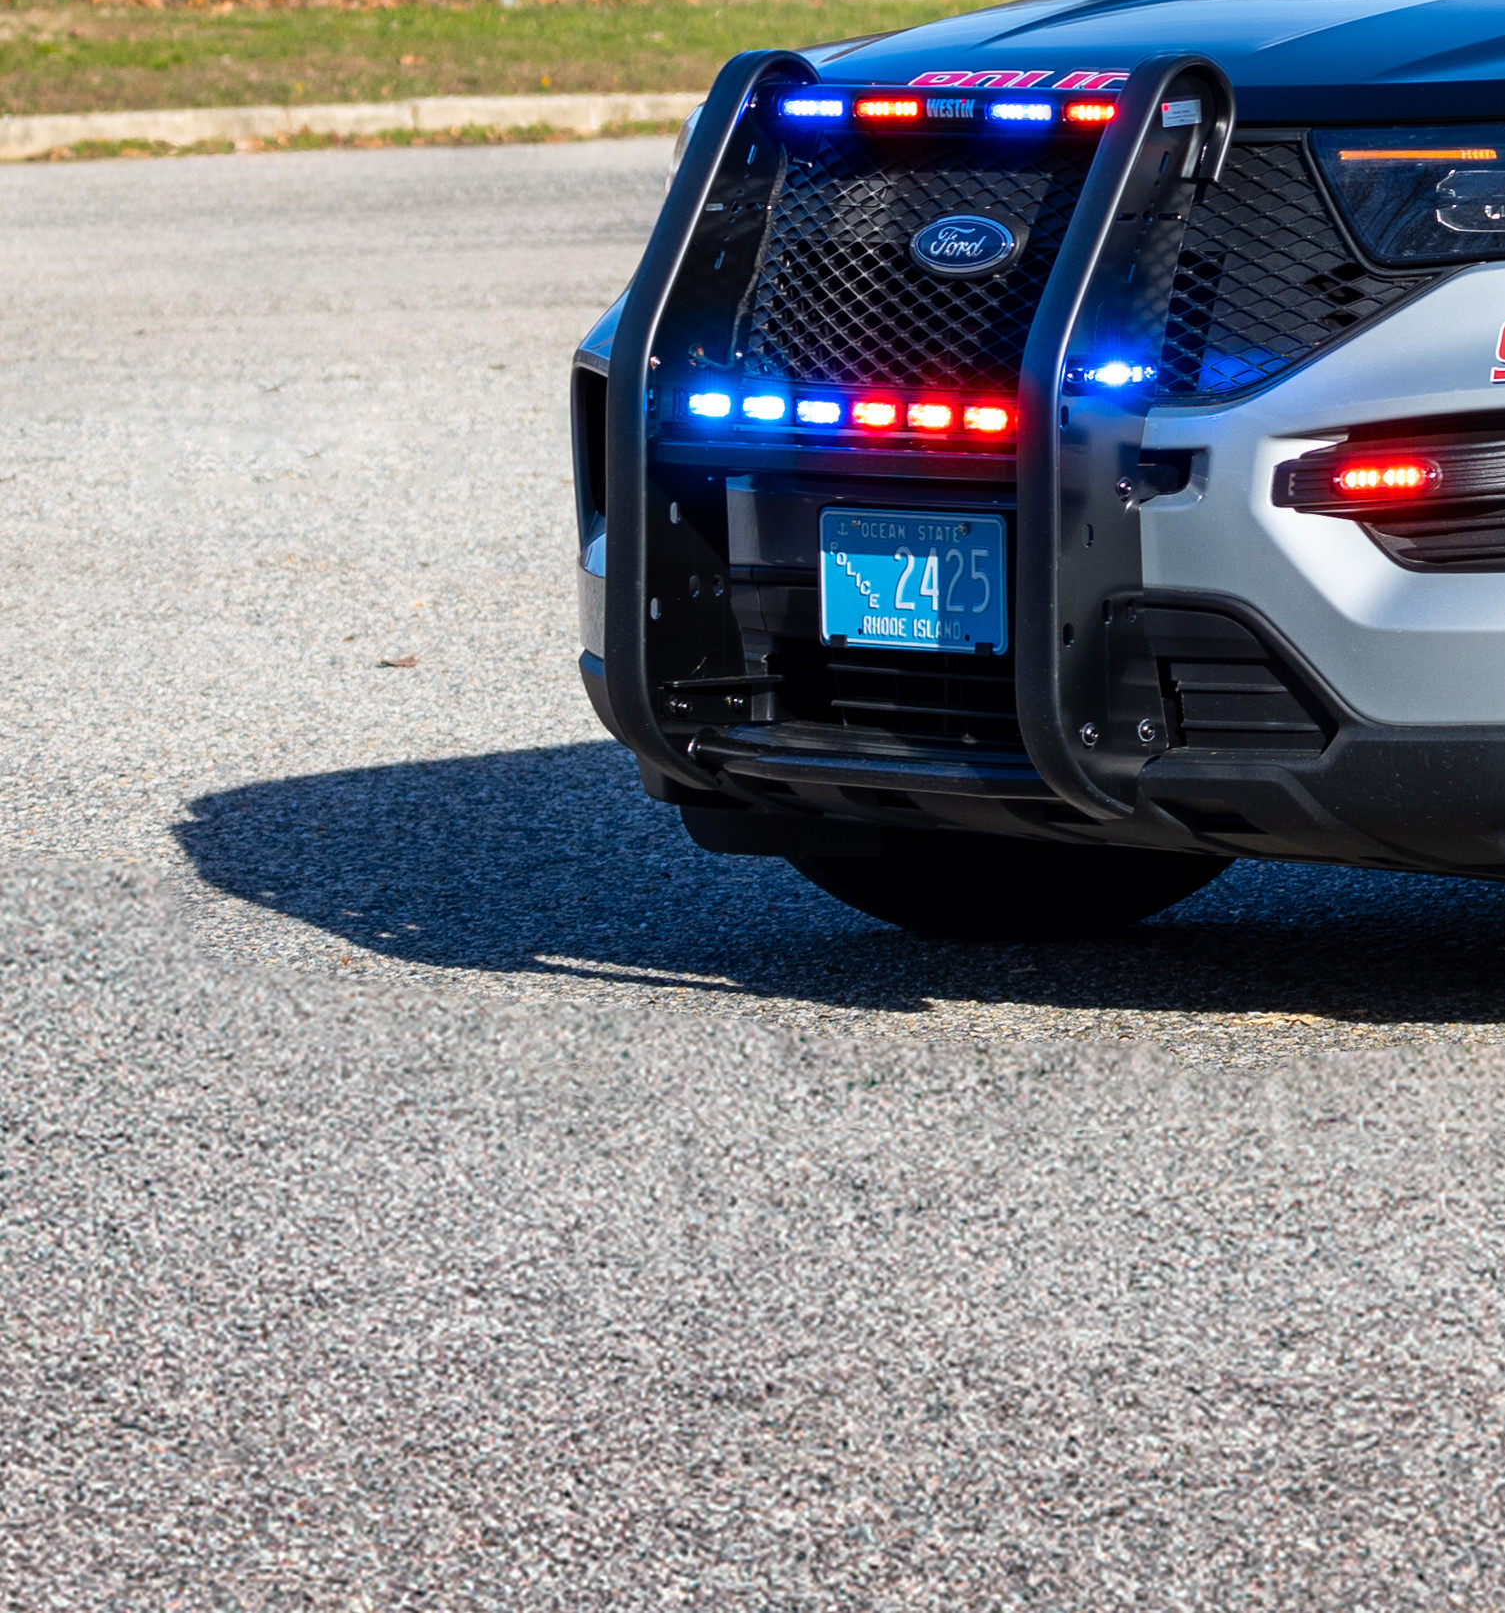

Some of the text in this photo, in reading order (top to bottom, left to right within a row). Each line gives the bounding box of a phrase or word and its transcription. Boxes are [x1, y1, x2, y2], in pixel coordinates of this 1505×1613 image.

[907, 70, 1130, 89] POLIC
[930, 226, 987, 257] Ford
[861, 522, 961, 543] OCEAN STATE
[829, 541, 880, 609] POLICE
[893, 545, 991, 614] 2425
[862, 616, 961, 640] RHODE ISLAND
